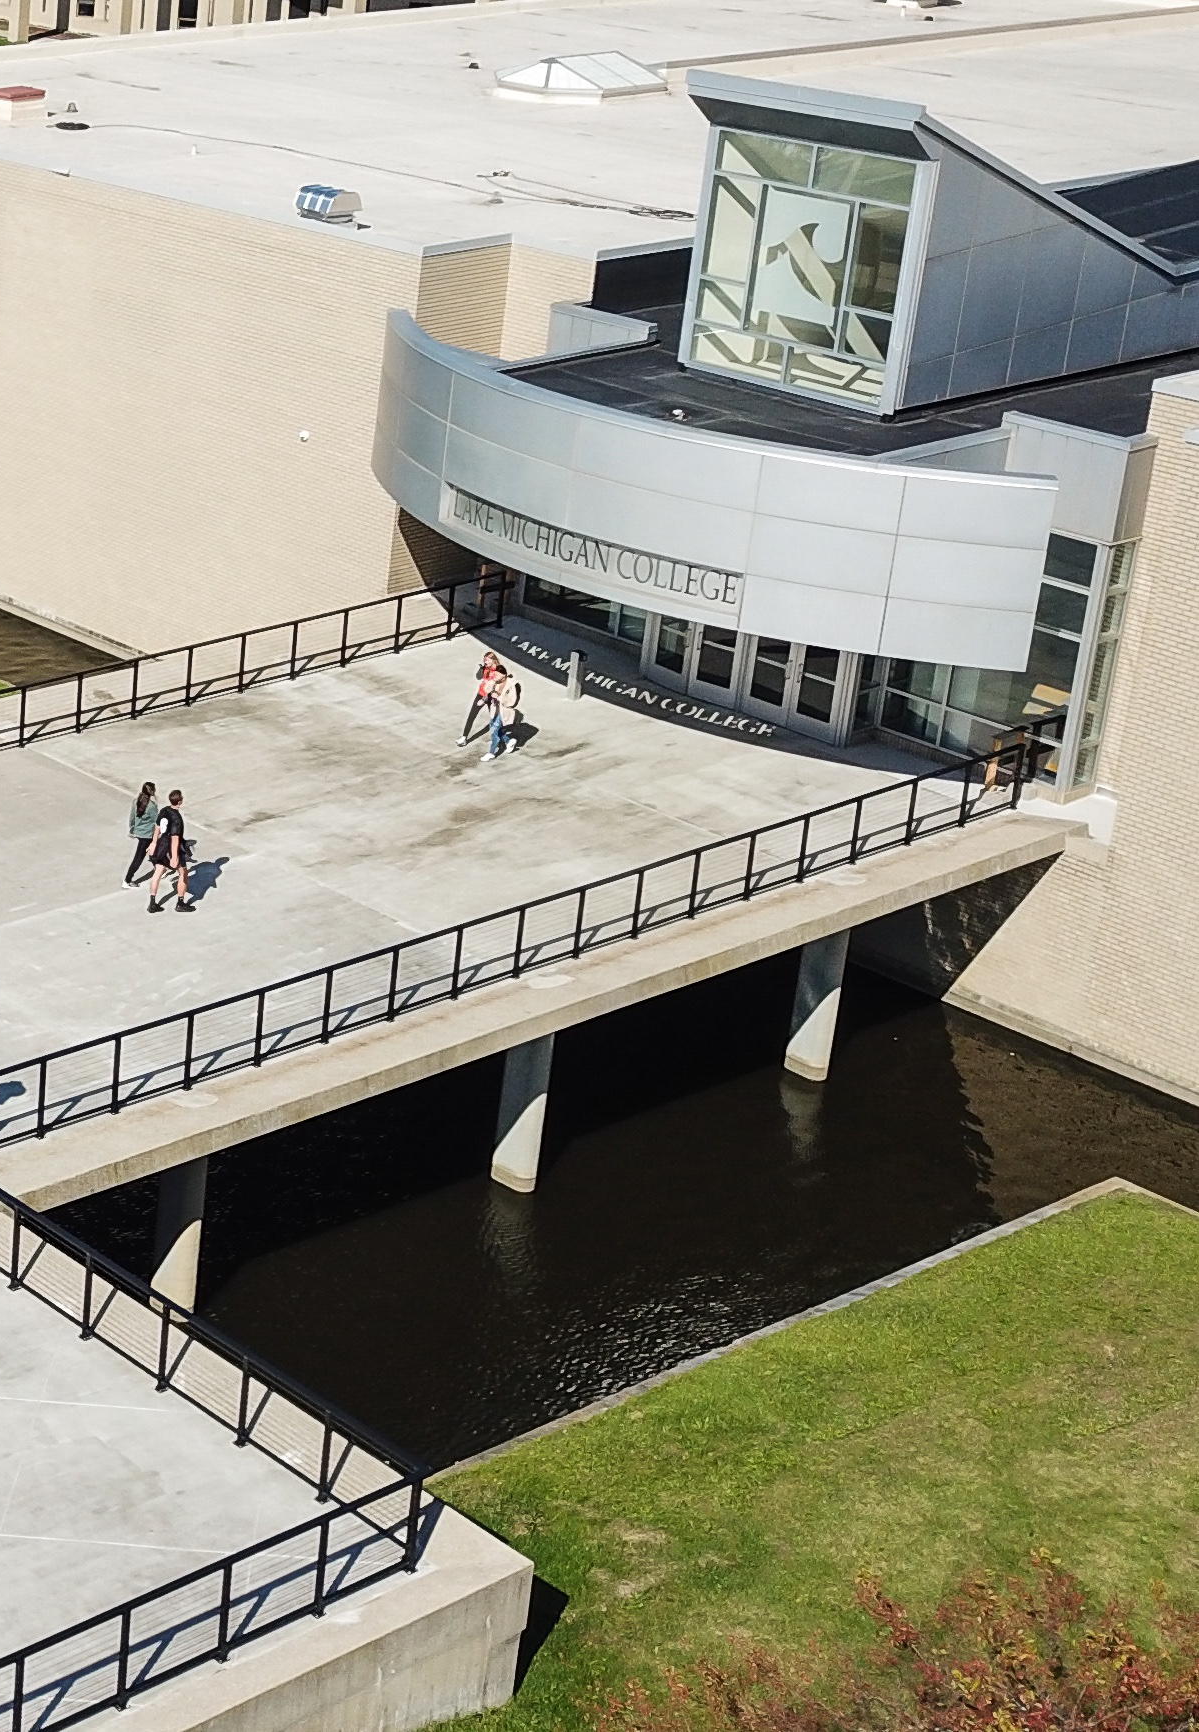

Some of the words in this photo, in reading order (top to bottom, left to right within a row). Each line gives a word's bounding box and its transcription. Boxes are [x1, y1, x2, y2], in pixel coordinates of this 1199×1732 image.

[453, 490, 494, 533] LAKE
[498, 511, 610, 573] MICHIGAN
[616, 549, 738, 605] COLLEGE
[551, 657, 658, 705] MHIGAN
[661, 698, 777, 738] COLLEGE
